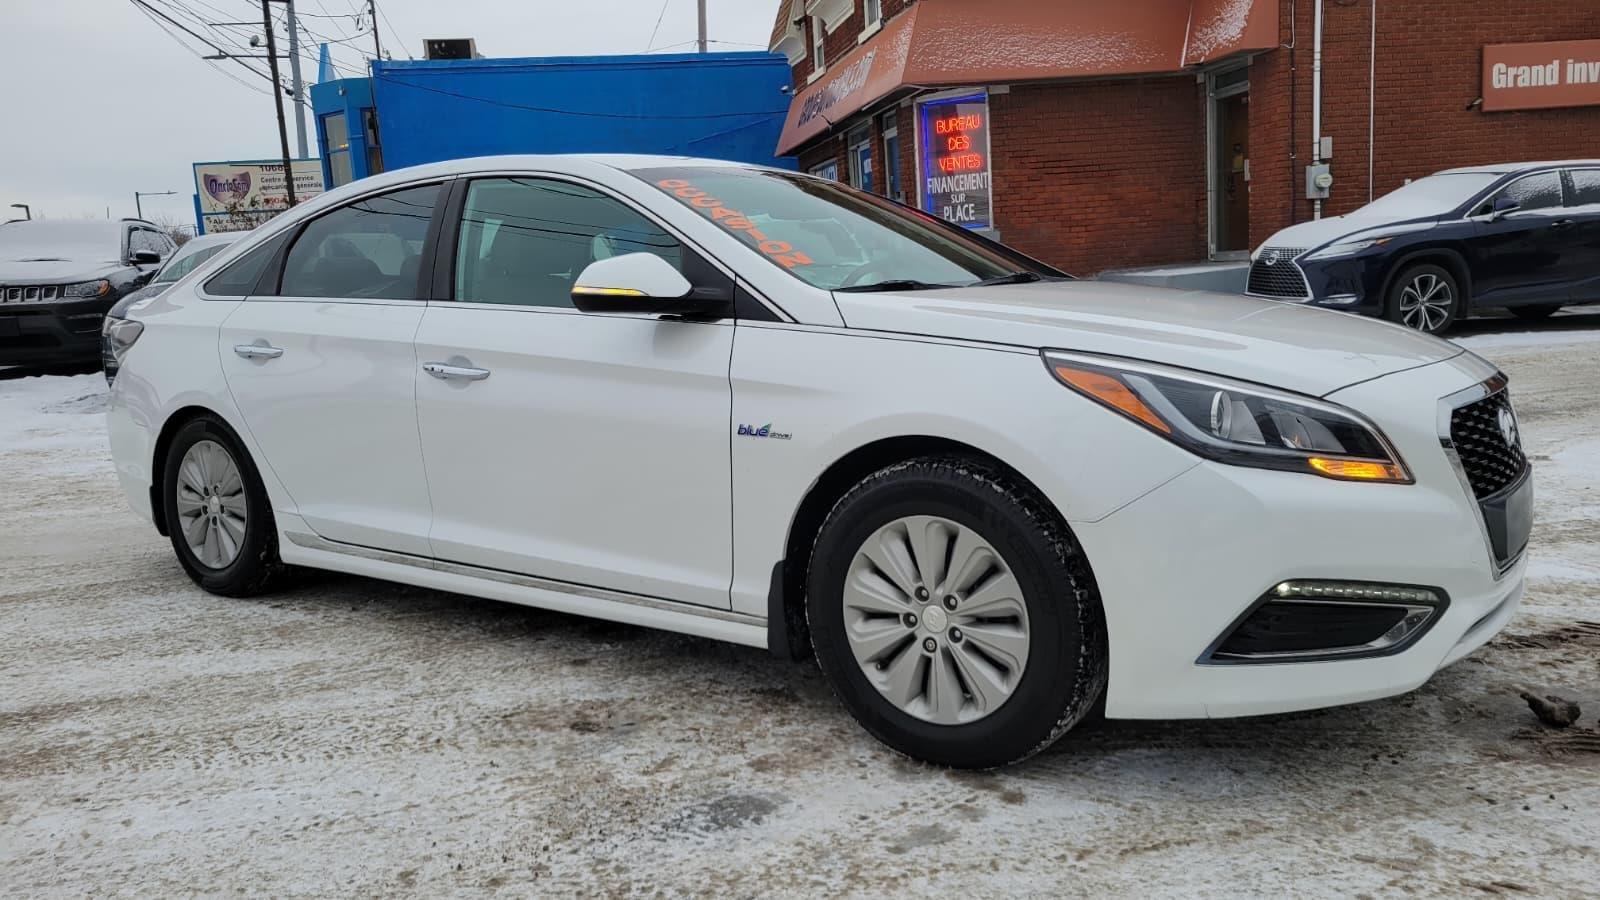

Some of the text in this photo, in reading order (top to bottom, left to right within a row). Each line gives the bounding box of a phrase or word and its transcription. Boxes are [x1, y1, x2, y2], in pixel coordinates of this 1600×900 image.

[1492, 60, 1560, 89] Grand
[936, 115, 981, 134] BUREAU
[948, 135, 970, 151] DES
[938, 154, 981, 172] VENTES
[927, 171, 988, 194] FINANCEMENT
[951, 193, 966, 203] SUR
[943, 203, 976, 222] PLACE
[658, 179, 815, 269] OCCASION
[737, 423, 769, 437] blue
